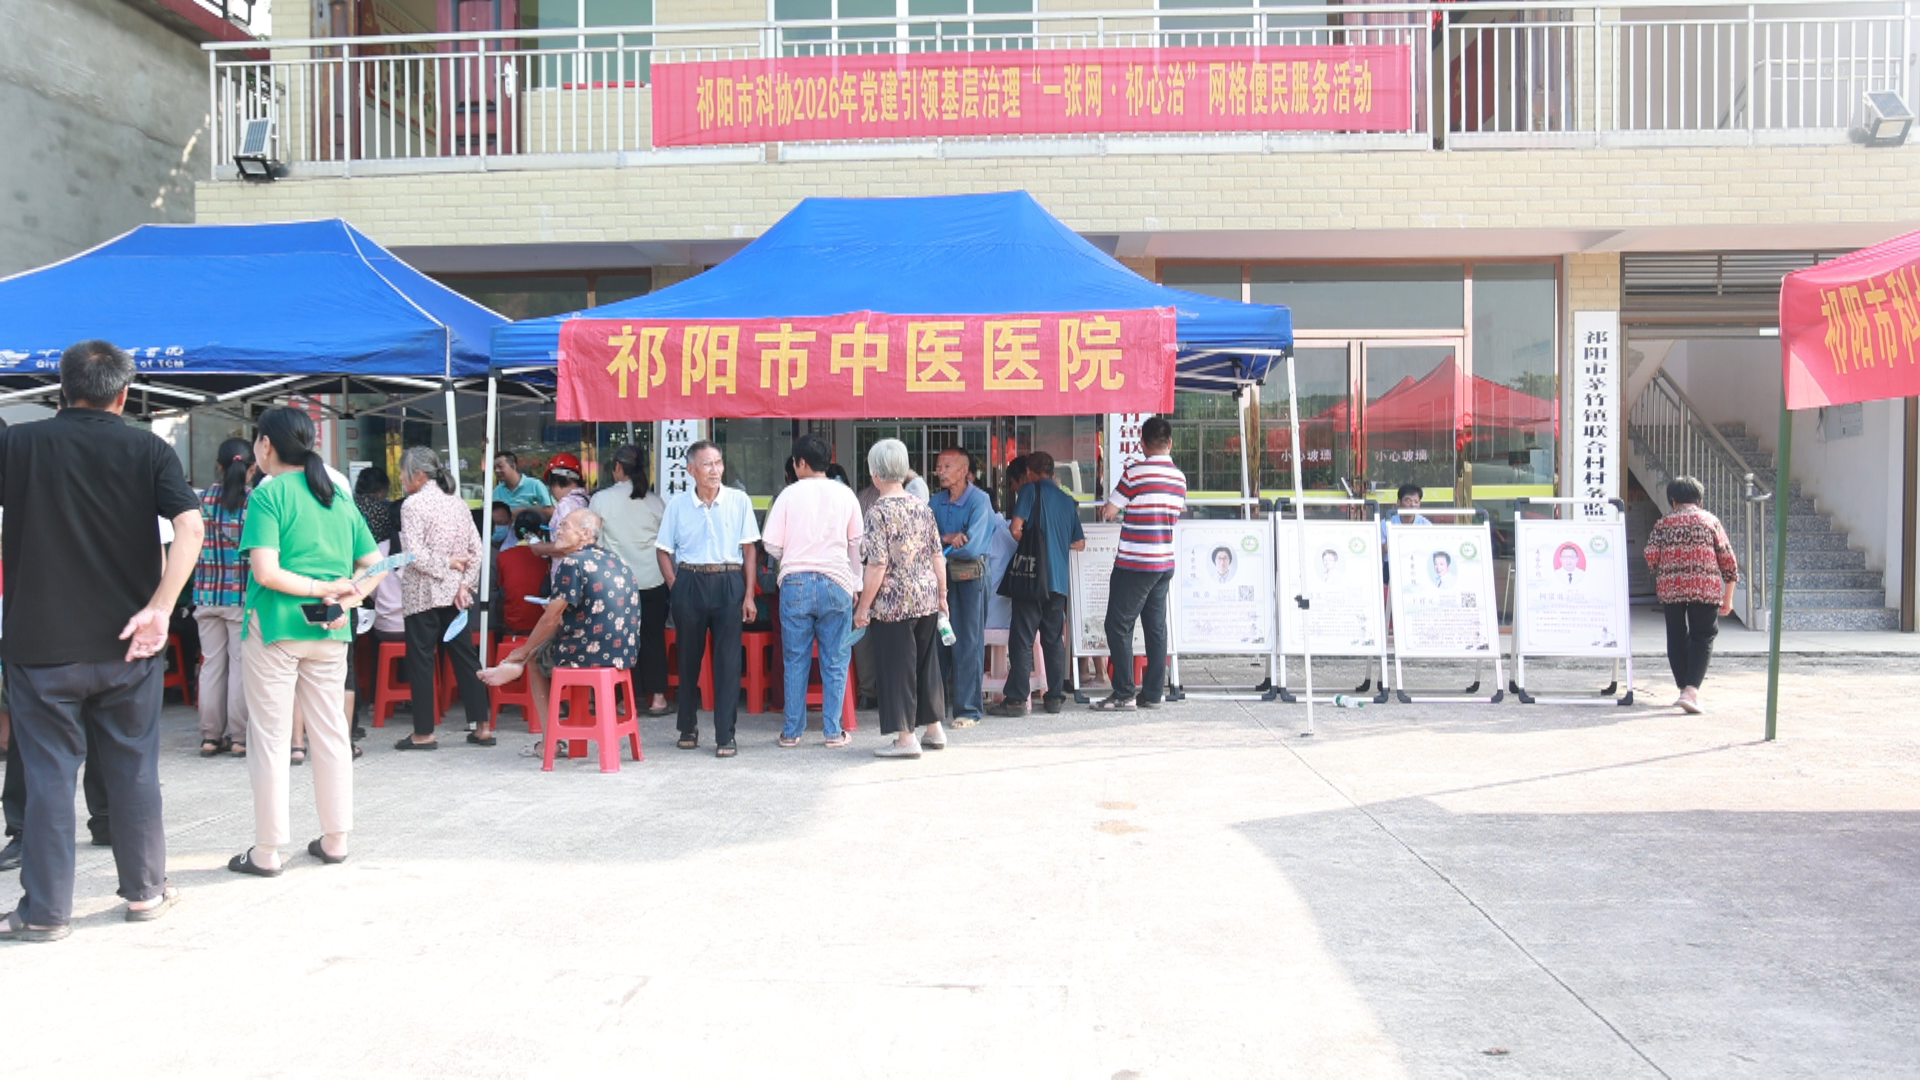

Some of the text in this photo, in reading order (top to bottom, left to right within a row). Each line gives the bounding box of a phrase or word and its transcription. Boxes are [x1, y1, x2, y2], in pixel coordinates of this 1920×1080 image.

[606, 315, 1126, 399] 祁阳市中医医院
[1820, 264, 1920, 375] 祁阳市科
[158, 359, 185, 368] TCM
[1376, 449, 1428, 463] 小心玻璃
[1583, 331, 1608, 521] 祁阳市茅竹镇联合村村务监
